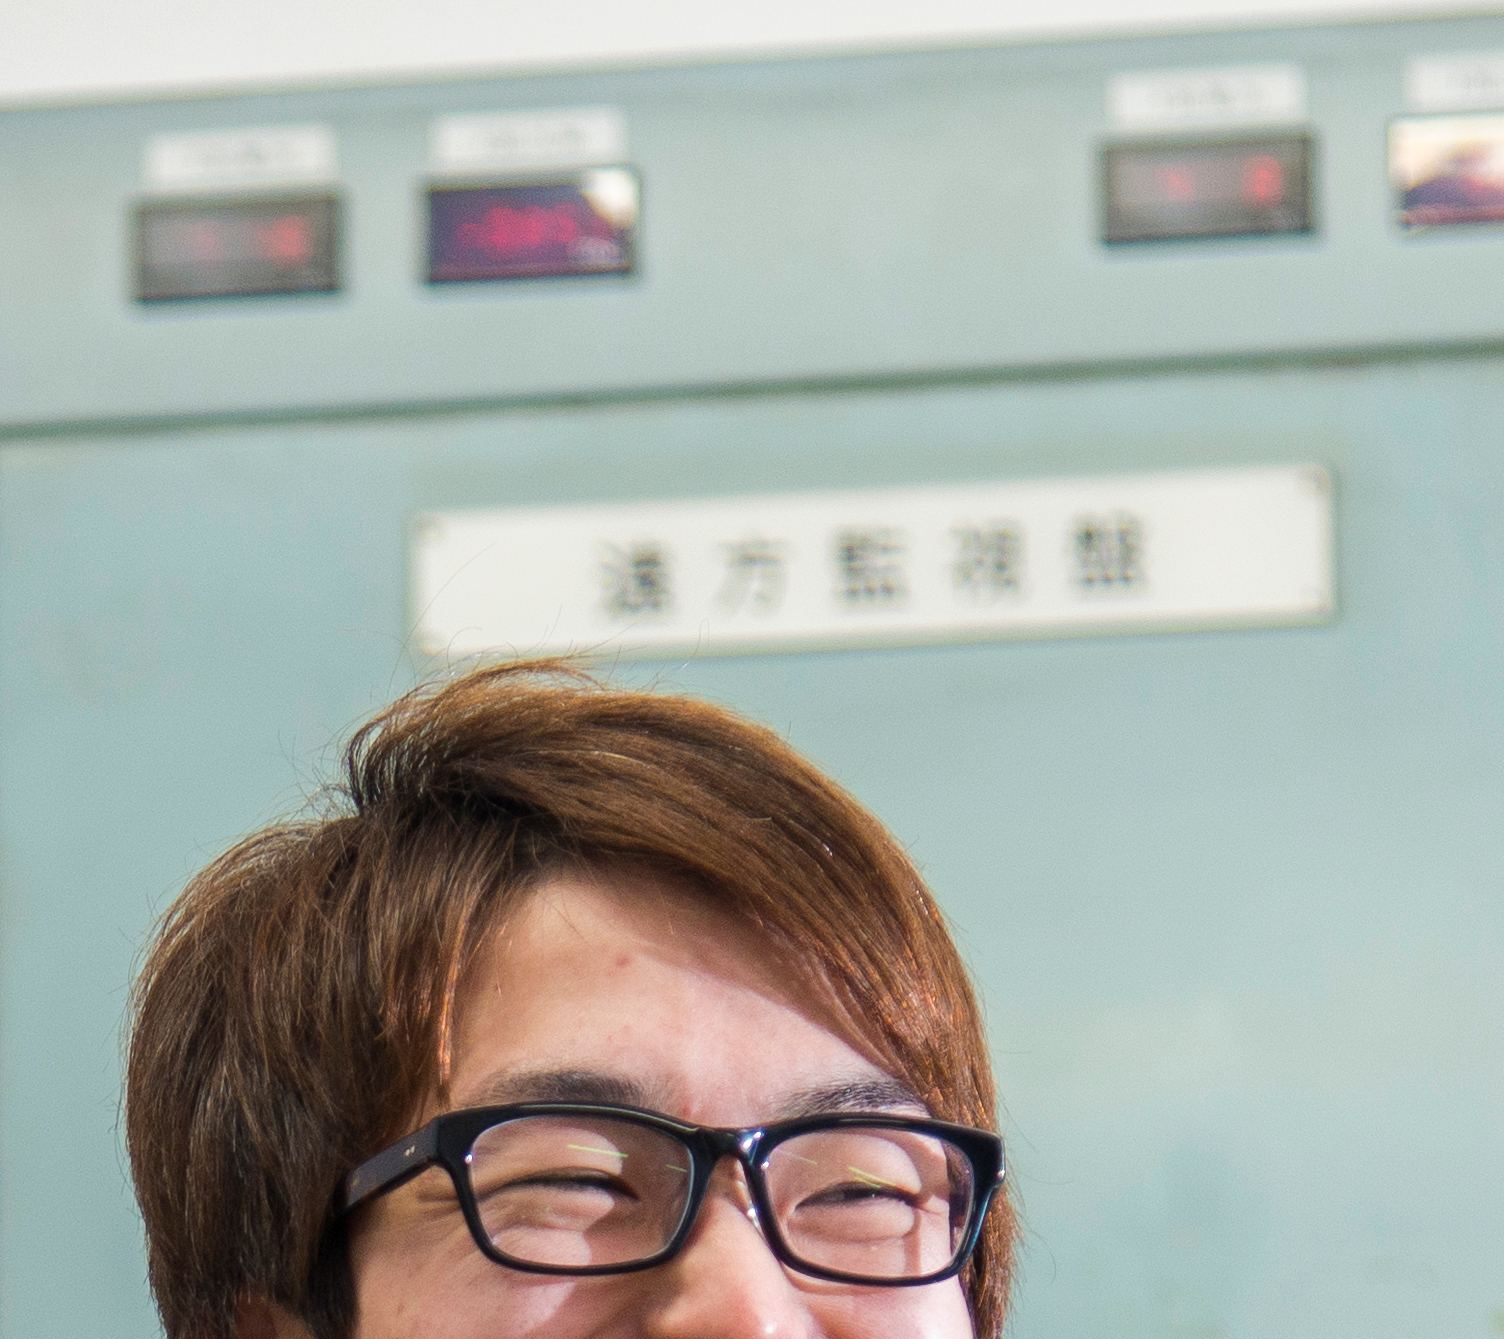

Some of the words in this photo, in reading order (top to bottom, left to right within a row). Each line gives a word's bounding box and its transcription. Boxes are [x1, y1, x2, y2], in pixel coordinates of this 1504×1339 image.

[598, 510, 1148, 620] 遠方監視盤
